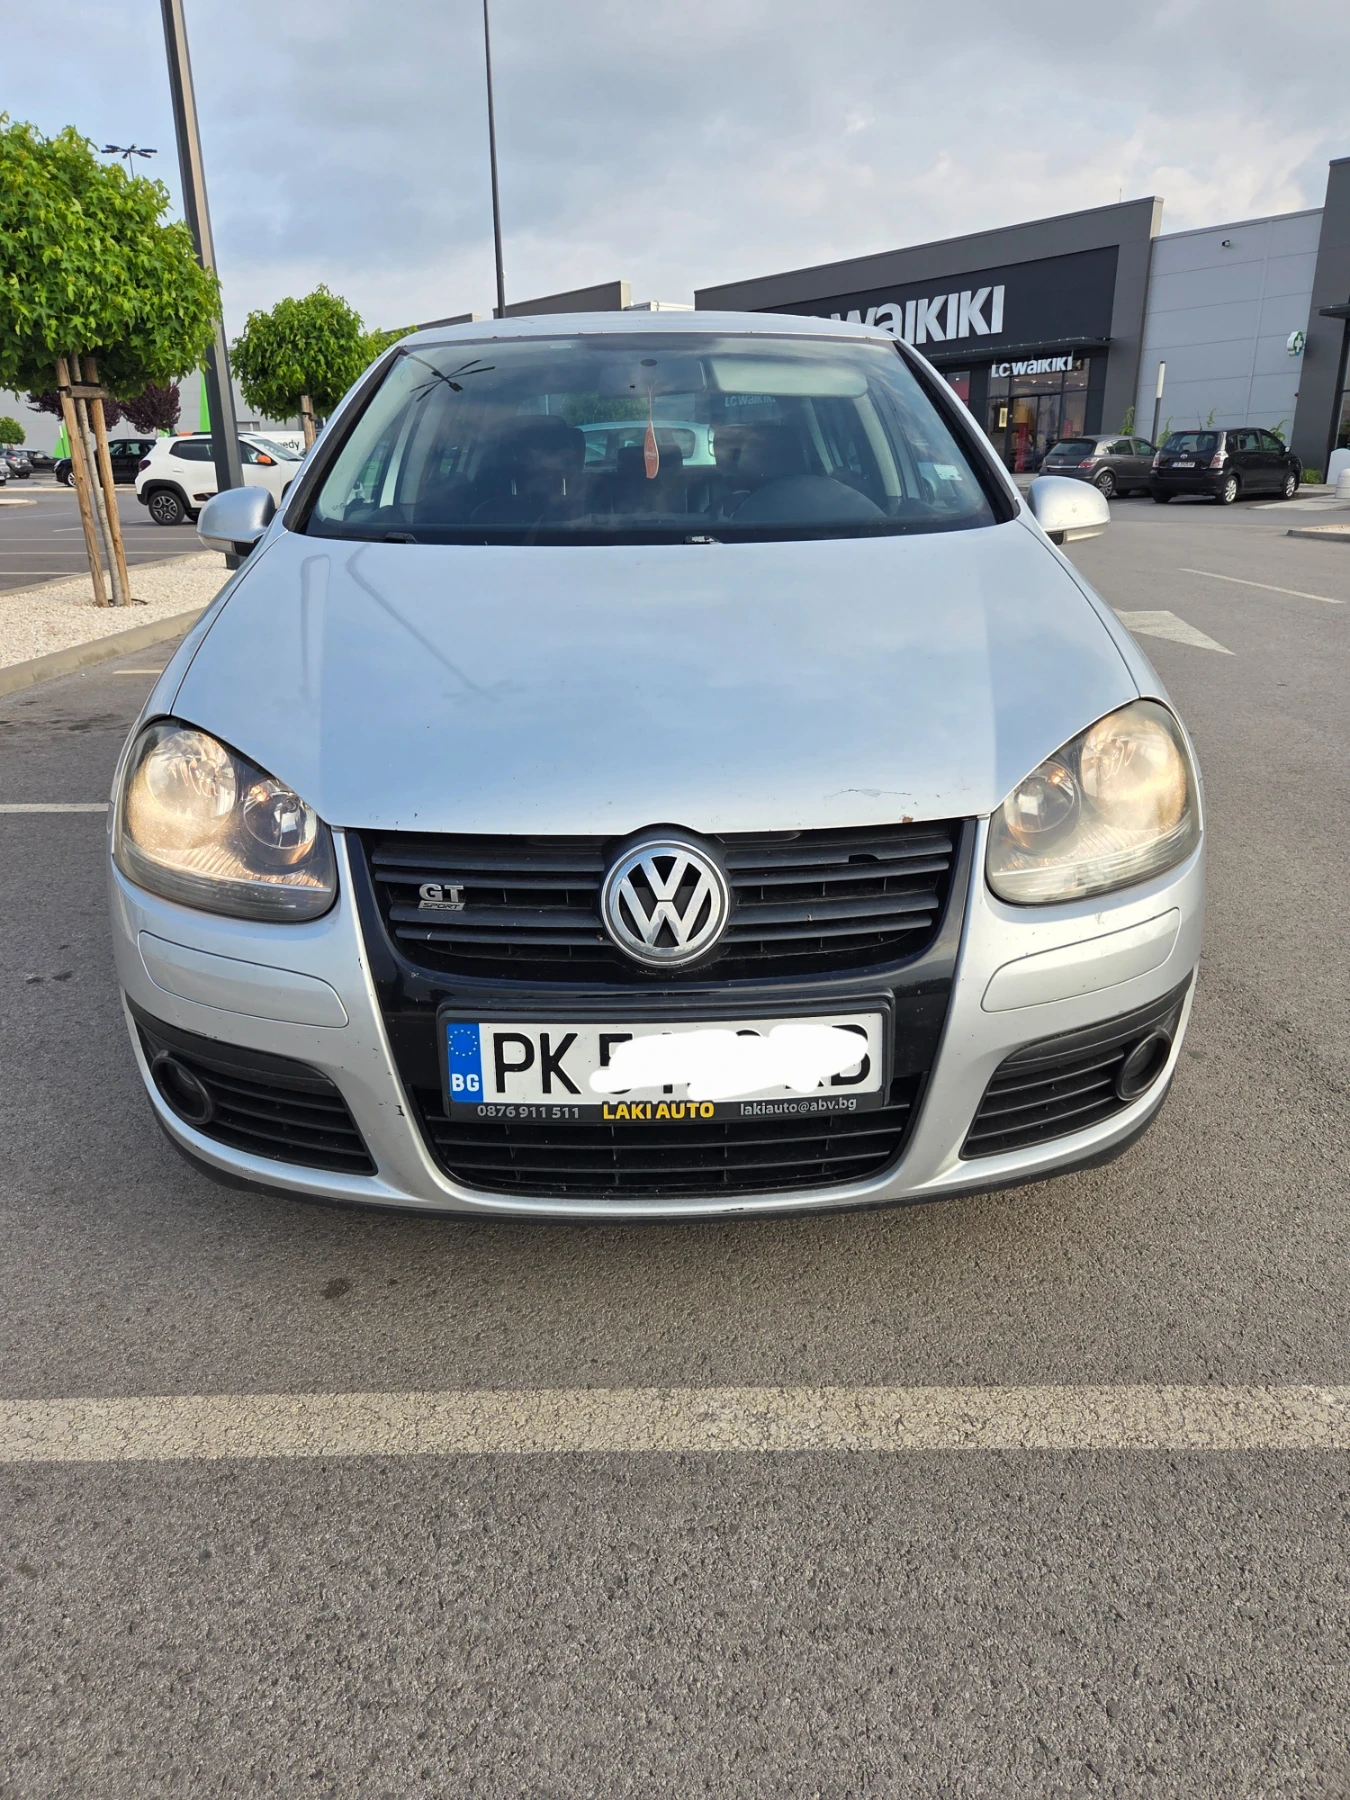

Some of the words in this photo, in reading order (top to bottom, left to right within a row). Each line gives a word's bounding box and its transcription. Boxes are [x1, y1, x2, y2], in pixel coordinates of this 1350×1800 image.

[831, 285, 1005, 345] aIKIKI
[991, 363, 1010, 378] LC
[419, 883, 464, 903] GT
[422, 902, 460, 910] SPORT
[493, 1032, 582, 1095] PK
[451, 1073, 480, 1092] BG
[477, 1105, 516, 1118] 0876
[519, 1106, 547, 1119] 911
[552, 1107, 580, 1119] 511
[602, 1103, 652, 1121] LAKI
[655, 1102, 715, 1120] AUTO
[739, 1097, 858, 1117] lakiauto@abv.bg
